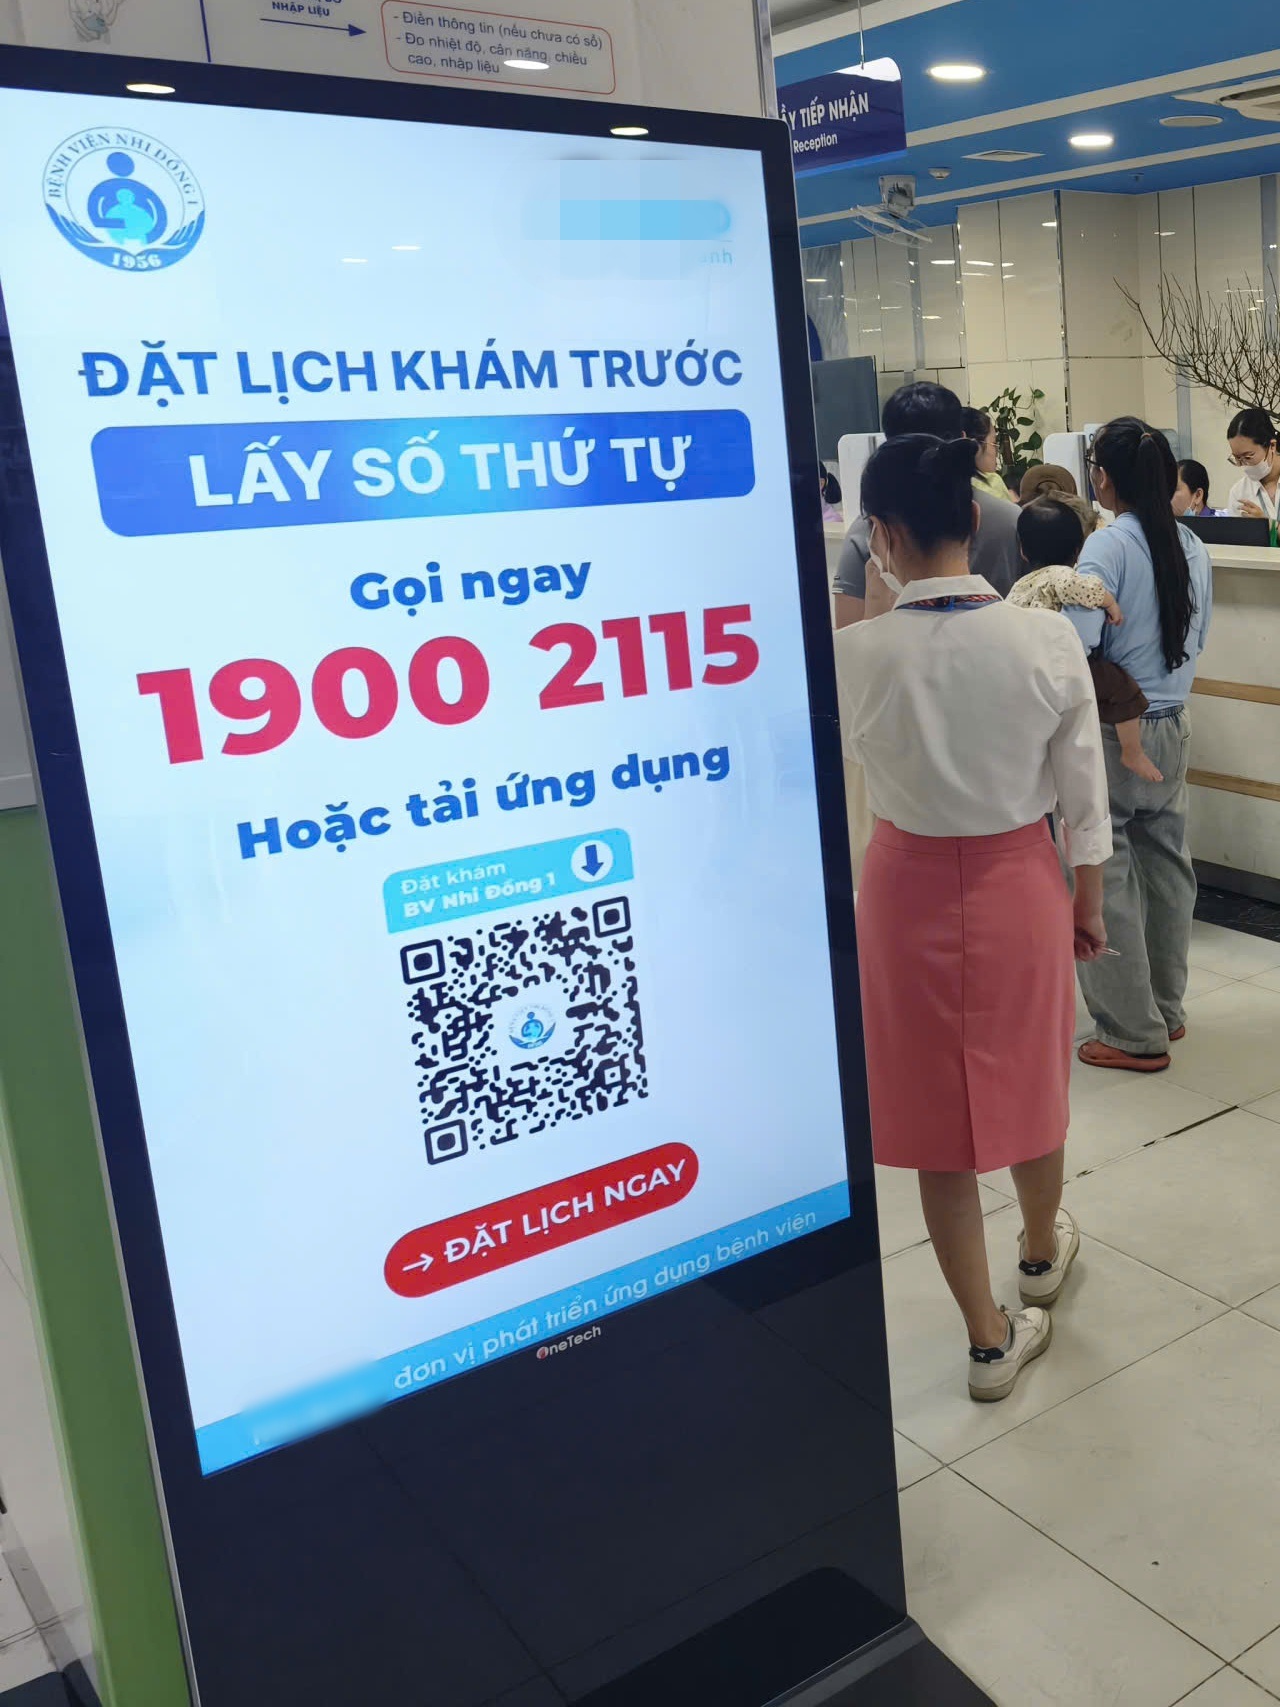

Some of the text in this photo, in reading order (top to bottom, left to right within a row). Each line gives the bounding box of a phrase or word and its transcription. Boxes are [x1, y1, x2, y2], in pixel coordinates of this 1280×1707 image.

[272, 1, 330, 17] NHẬP LIỆU
[402, 11, 434, 26] Điền
[438, 16, 475, 34] thông
[479, 19, 495, 34] tin
[499, 23, 527, 39] (nếu
[530, 28, 562, 43] chưa
[566, 33, 580, 45] có
[583, 34, 603, 50] số)
[405, 32, 424, 46] Đo
[429, 35, 461, 52] nhiệt
[489, 43, 512, 57] cân
[555, 50, 588, 66] chiều
[441, 56, 473, 73] nhập
[477, 59, 500, 74] liệu
[779, 90, 870, 130] ẦY TIẾP NHẬN
[793, 133, 838, 154] Reception
[46, 153, 71, 198] BỆNH
[67, 133, 111, 154] VIỆN
[116, 133, 151, 152] NHI
[111, 252, 162, 269] 1956
[78, 339, 743, 408] ĐẶT LỊCH KHÁM TRƯỚC
[188, 427, 693, 507] LẤY SỐ THỨ TỰ
[350, 560, 592, 616] Gọi ngay
[136, 603, 760, 764] 1900 2115
[236, 745, 731, 860] Hoặc tải ứng dụng
[401, 862, 507, 895] Đặt khám
[403, 872, 556, 919] BV Nhi Đồng 1
[444, 1159, 688, 1258] ĐẶT LỊCH NGAY
[393, 1209, 817, 1389] đơn vị phát triển ứng dụng bệnh viện
[536, 1325, 602, 1360] OneTech
